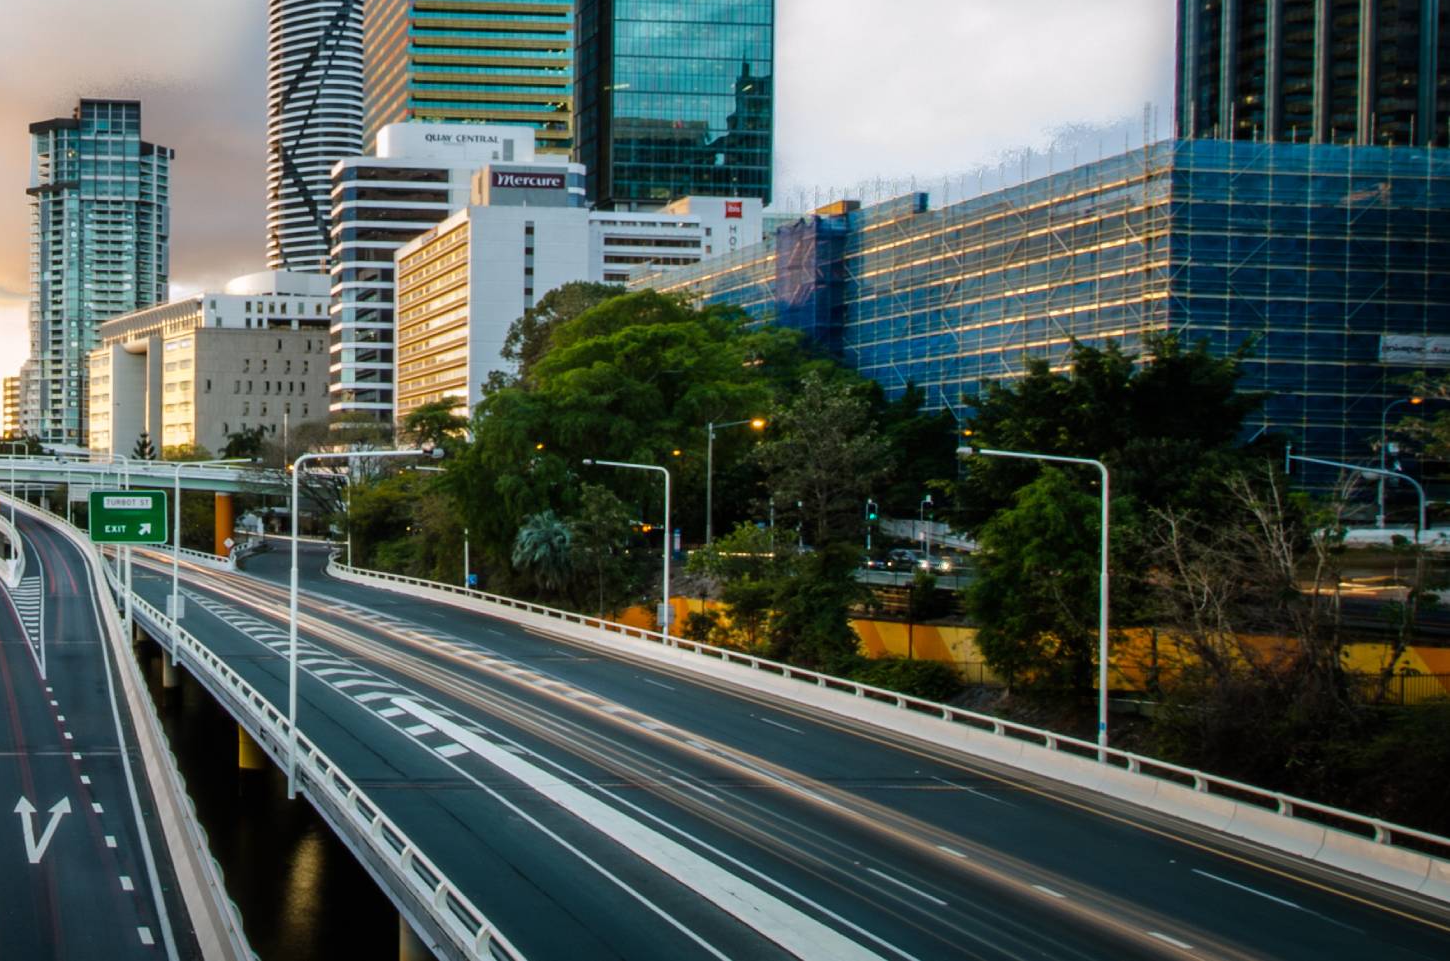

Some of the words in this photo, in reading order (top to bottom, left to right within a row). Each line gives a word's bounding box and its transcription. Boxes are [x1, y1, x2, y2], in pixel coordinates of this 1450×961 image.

[425, 133, 452, 143] QUAY
[456, 134, 499, 144] CENTRAL
[497, 173, 561, 187] Mercure
[105, 498, 136, 507] TURBOT
[105, 525, 126, 534] EXIT
